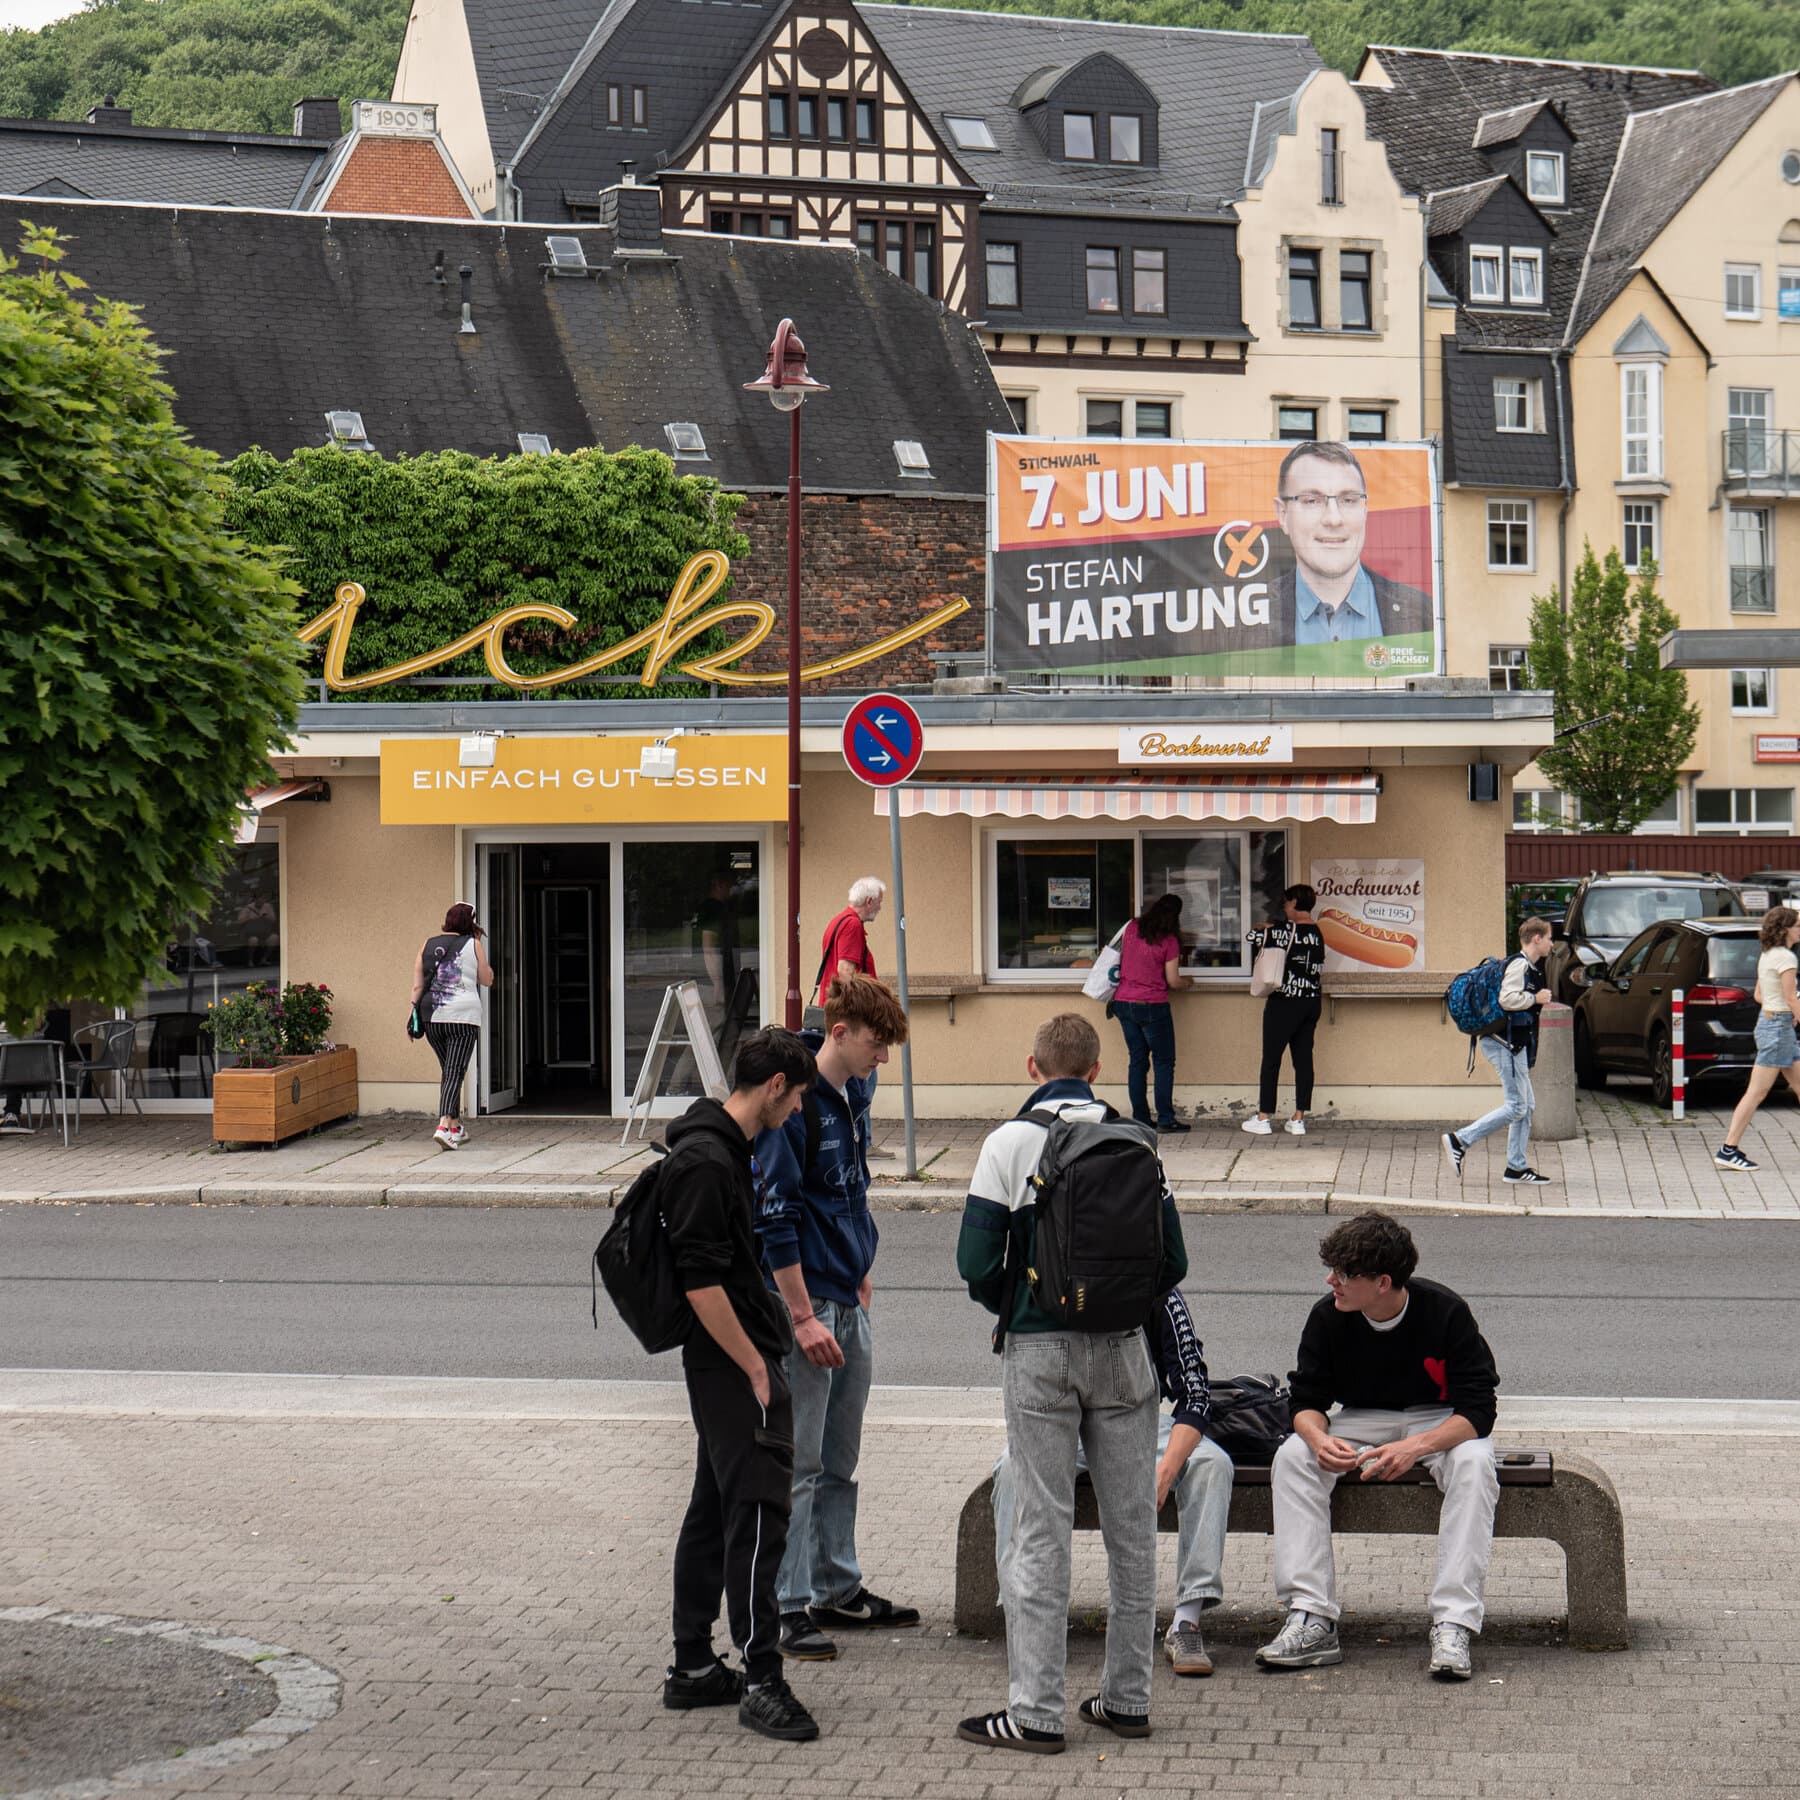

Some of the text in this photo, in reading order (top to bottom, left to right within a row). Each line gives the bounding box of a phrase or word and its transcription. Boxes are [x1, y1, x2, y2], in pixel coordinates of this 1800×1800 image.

[377, 109, 418, 127] 1900
[1018, 452, 1101, 471] STICHWAHL
[1020, 462, 1207, 529] 7. JUNI
[1026, 555, 1143, 593] STEFAN
[1026, 583, 1271, 646] HARTUNG
[1390, 647, 1415, 656] FREIE
[1390, 655, 1429, 664] SACHSEN
[1138, 732, 1272, 757] Bockwurst
[413, 769, 560, 789] EINFACH
[572, 768, 640, 788] GUT
[1315, 877, 1422, 897] Bockwurst
[1367, 906, 1411, 920] seit 1954
